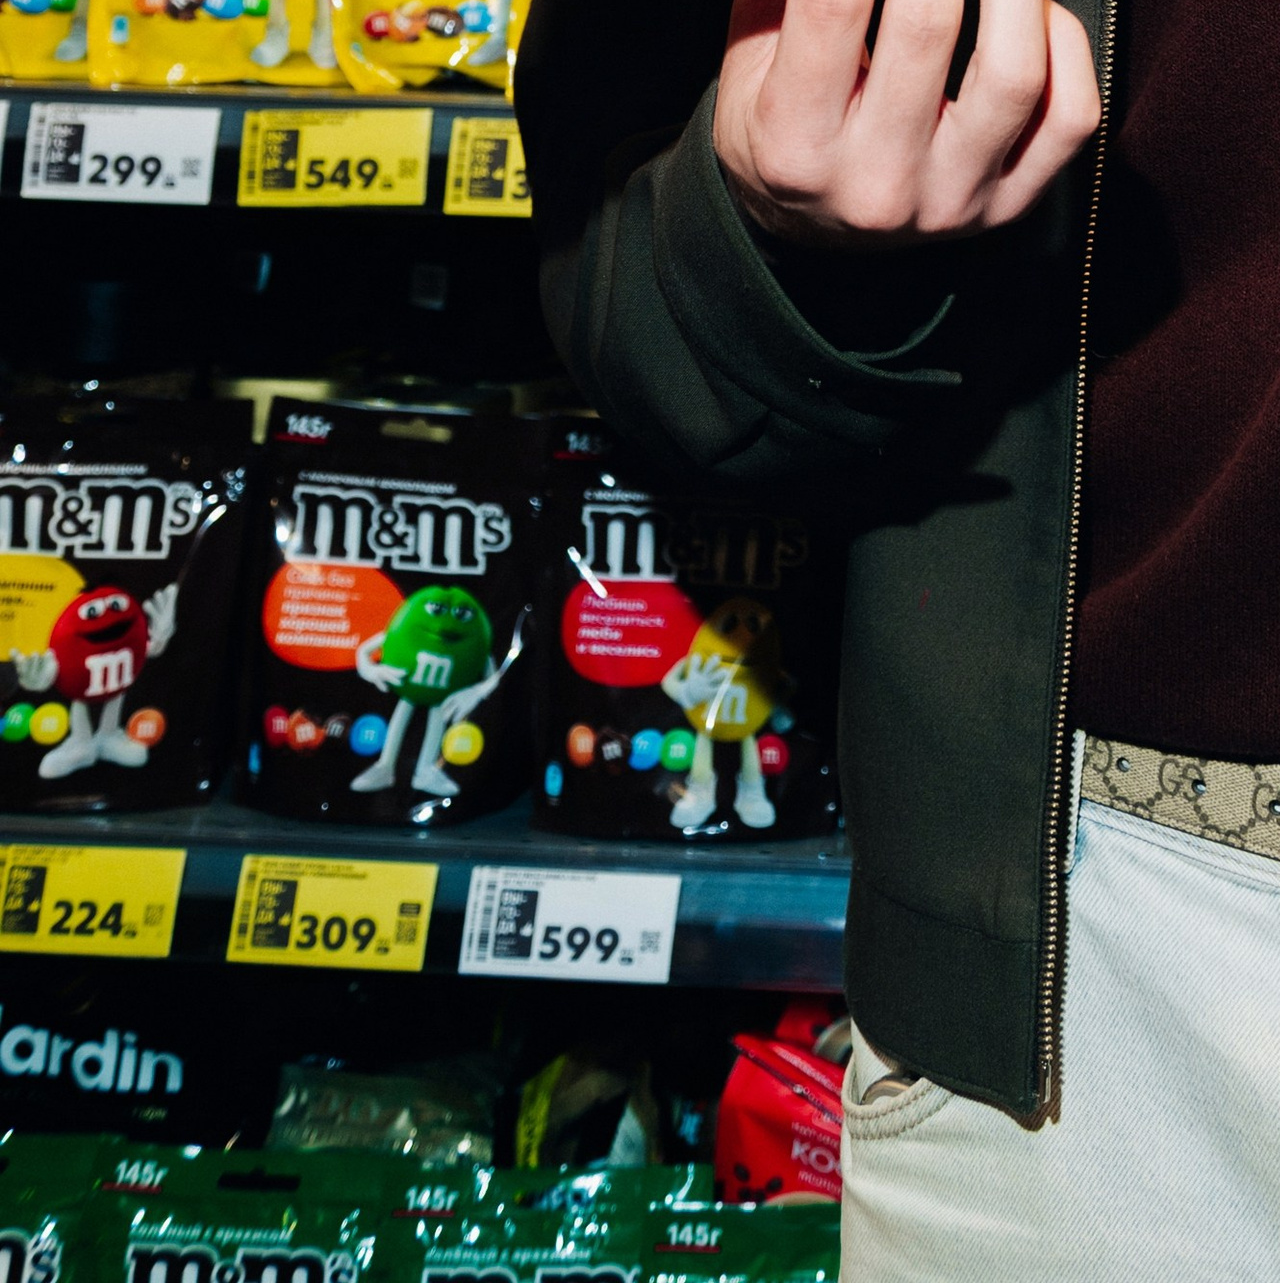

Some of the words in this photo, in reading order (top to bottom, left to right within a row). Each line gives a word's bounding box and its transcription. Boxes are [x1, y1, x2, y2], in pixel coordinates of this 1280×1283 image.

[88, 154, 162, 187] 299
[304, 158, 379, 190] 549
[84, 647, 134, 697] m
[411, 651, 455, 688] m
[50, 900, 124, 938] 224
[295, 913, 377, 954] 309
[538, 925, 620, 963] 599
[0, 1023, 184, 1094] ardin
